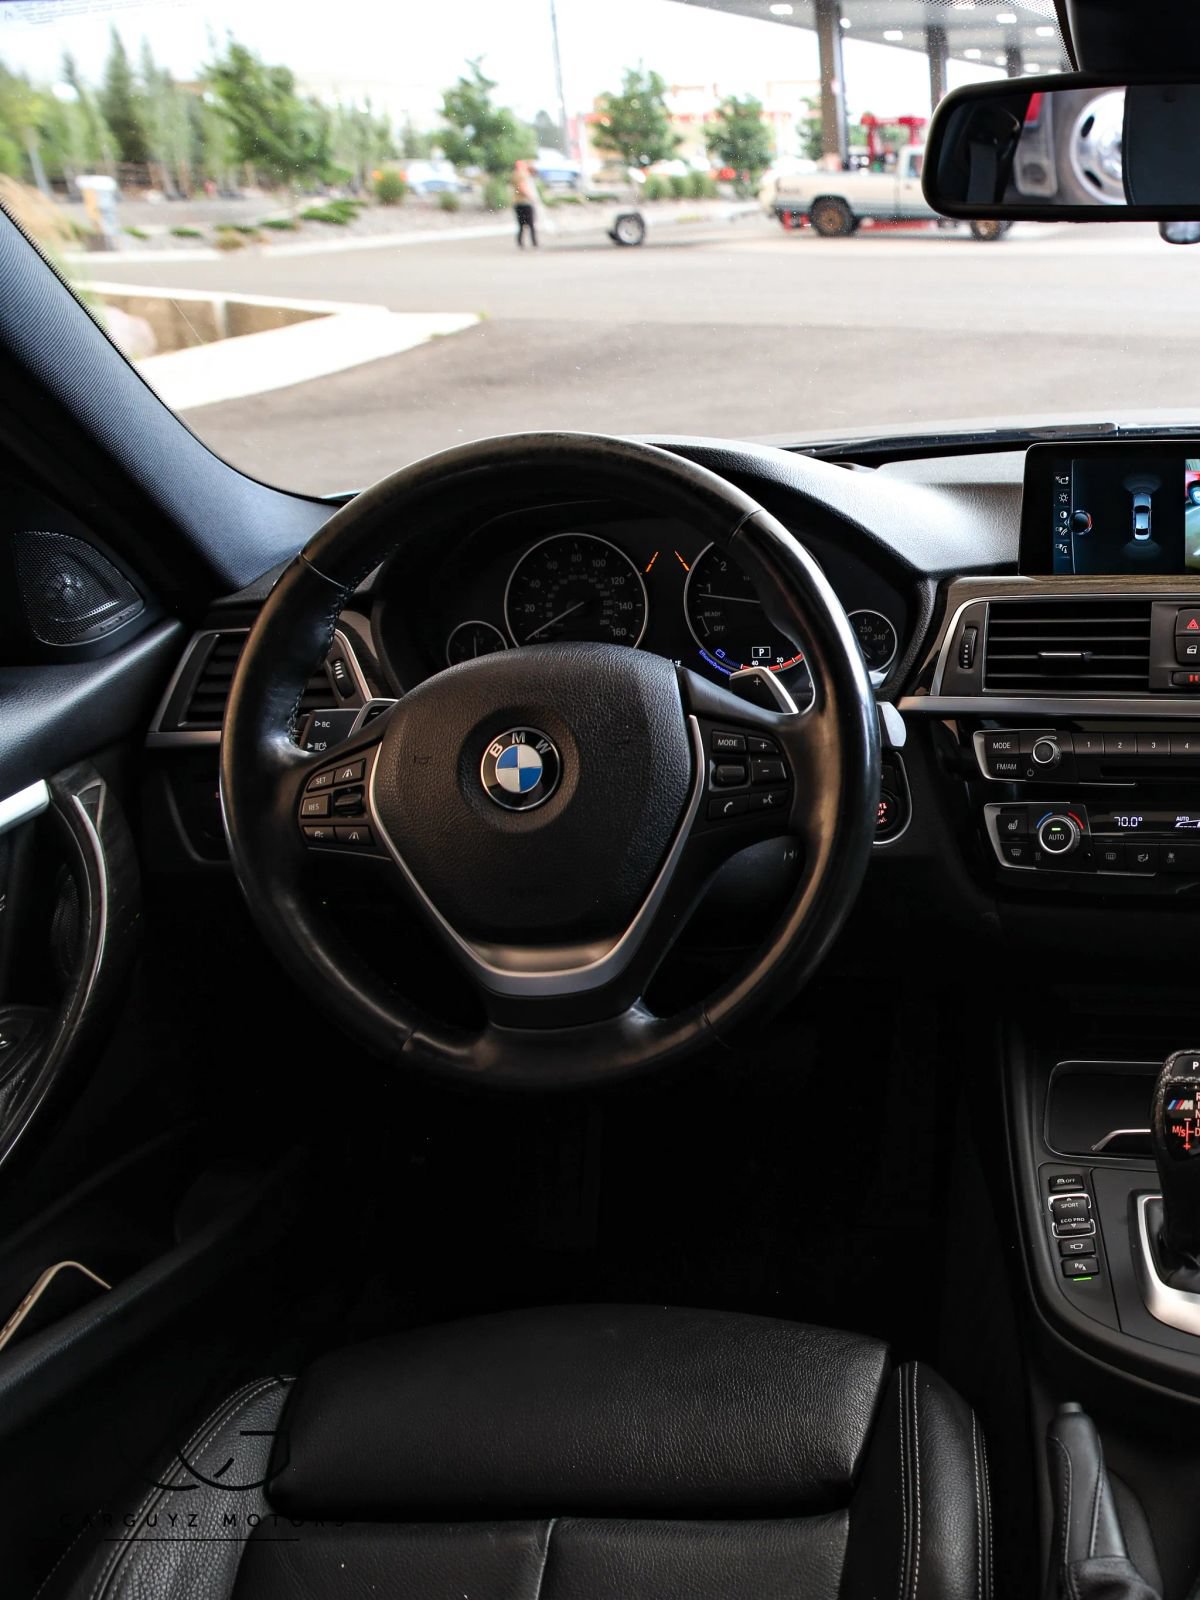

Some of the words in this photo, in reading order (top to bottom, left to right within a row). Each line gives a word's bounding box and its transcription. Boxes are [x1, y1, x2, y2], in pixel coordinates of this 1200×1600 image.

[546, 561, 558, 570] 60
[592, 560, 606, 568] 100
[720, 561, 727, 572] 2
[530, 580, 541, 588] 40
[611, 577, 625, 585] 120
[524, 604, 535, 613] 20
[619, 602, 633, 610] 140
[613, 628, 627, 636] 160
[758, 648, 765, 657] P
[489, 731, 552, 758] BMW
[717, 738, 738, 747] MODE
[992, 741, 1011, 749] MODE
[996, 762, 1017, 771] FM/AM
[1048, 833, 1065, 841] AUTO
[1192, 1061, 1199, 1070] P
[1172, 1125, 1186, 1138] M/S
